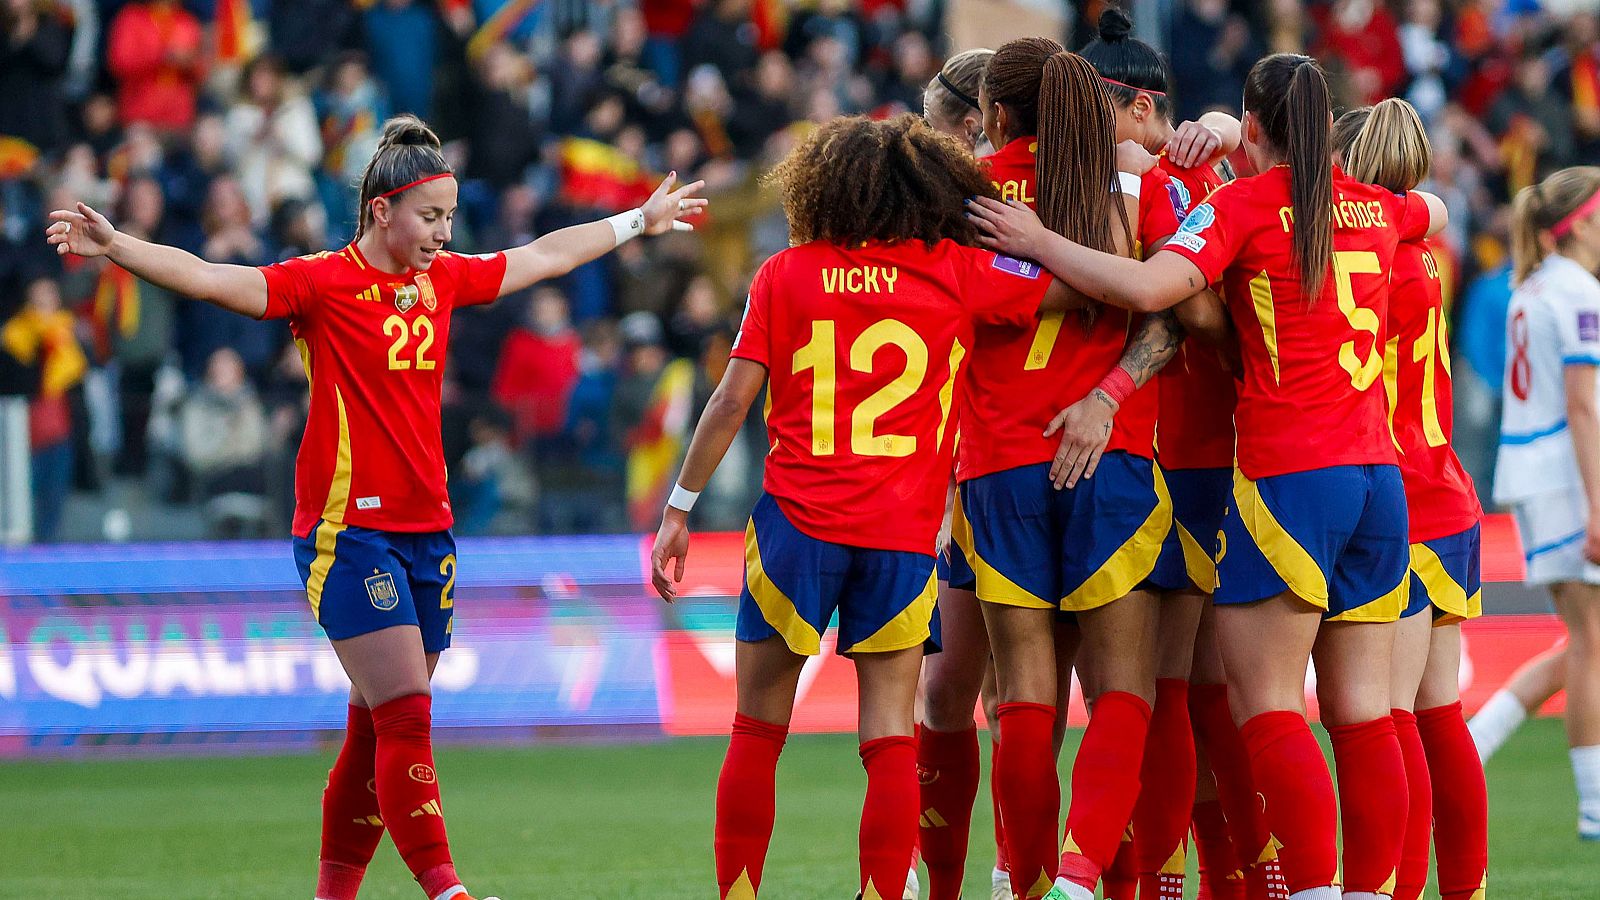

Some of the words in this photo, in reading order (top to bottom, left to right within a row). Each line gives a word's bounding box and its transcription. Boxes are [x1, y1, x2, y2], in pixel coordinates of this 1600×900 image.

[821, 265, 899, 295] VICKY
[1333, 251, 1384, 392] 5
[382, 314, 437, 370] 22
[791, 318, 929, 457] 12
